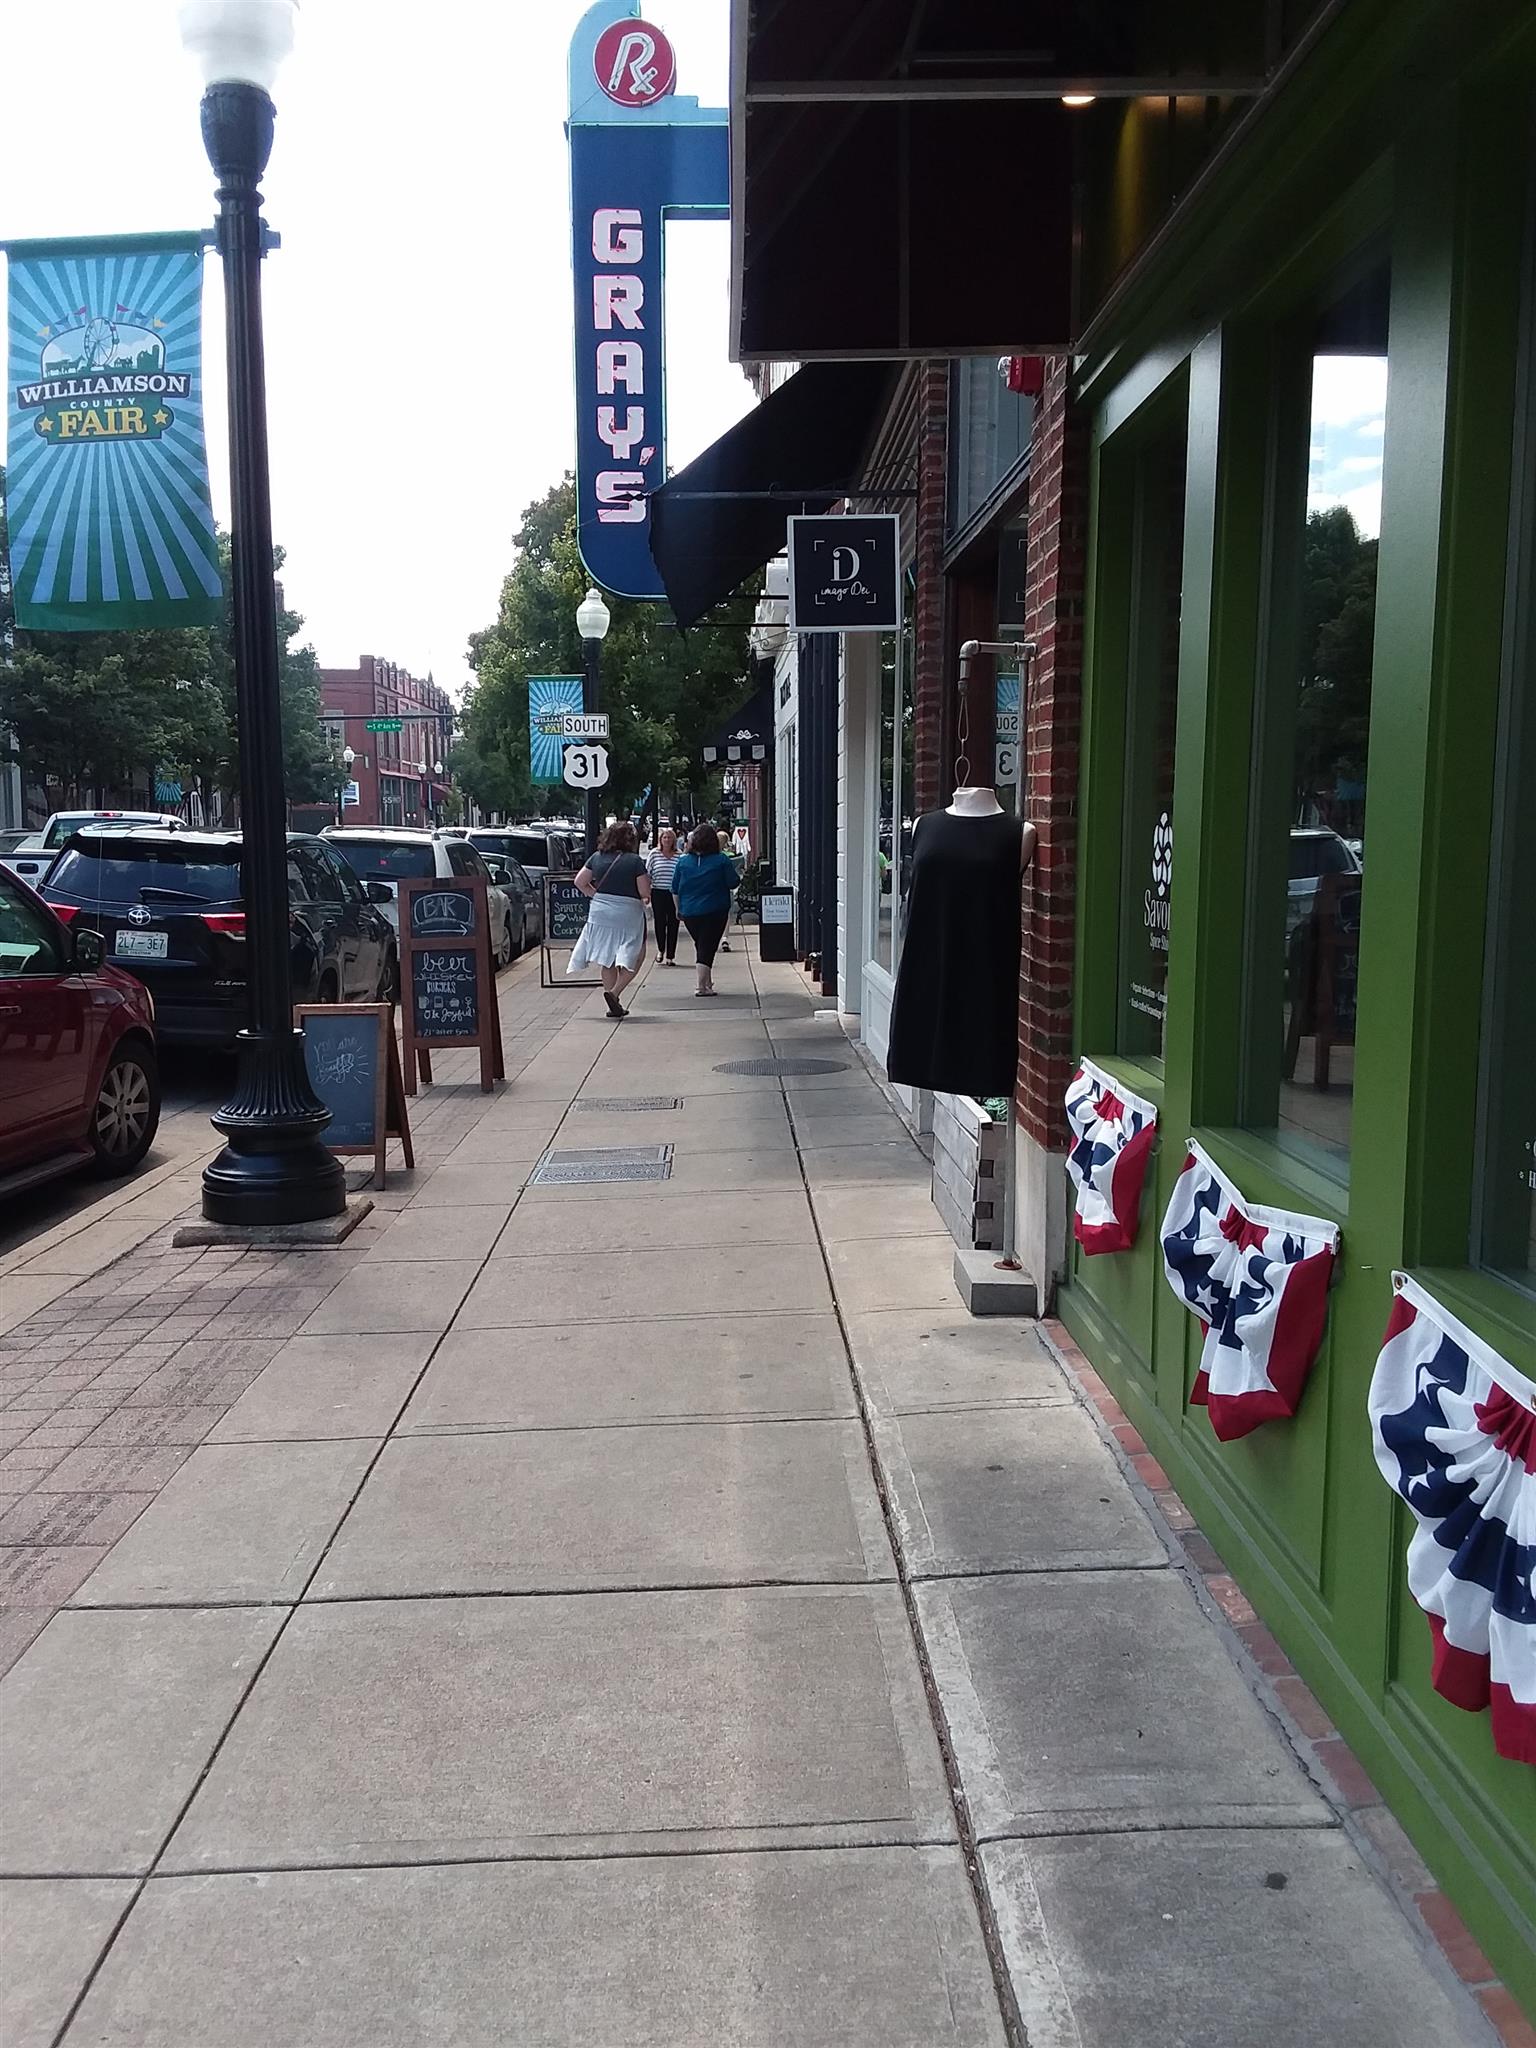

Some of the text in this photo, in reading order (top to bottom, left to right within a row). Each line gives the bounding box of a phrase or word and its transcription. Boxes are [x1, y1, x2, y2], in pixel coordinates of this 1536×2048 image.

[592, 208, 656, 523] GRAY'S
[20, 375, 187, 403] WILLIAMSON
[70, 398, 136, 409] COUNTY
[58, 407, 147, 437] FAIR
[544, 725, 562, 733] FAI
[565, 717, 606, 733] SOUTH
[572, 753, 599, 779] 31
[422, 896, 457, 918] BAR
[421, 951, 473, 973] beer
